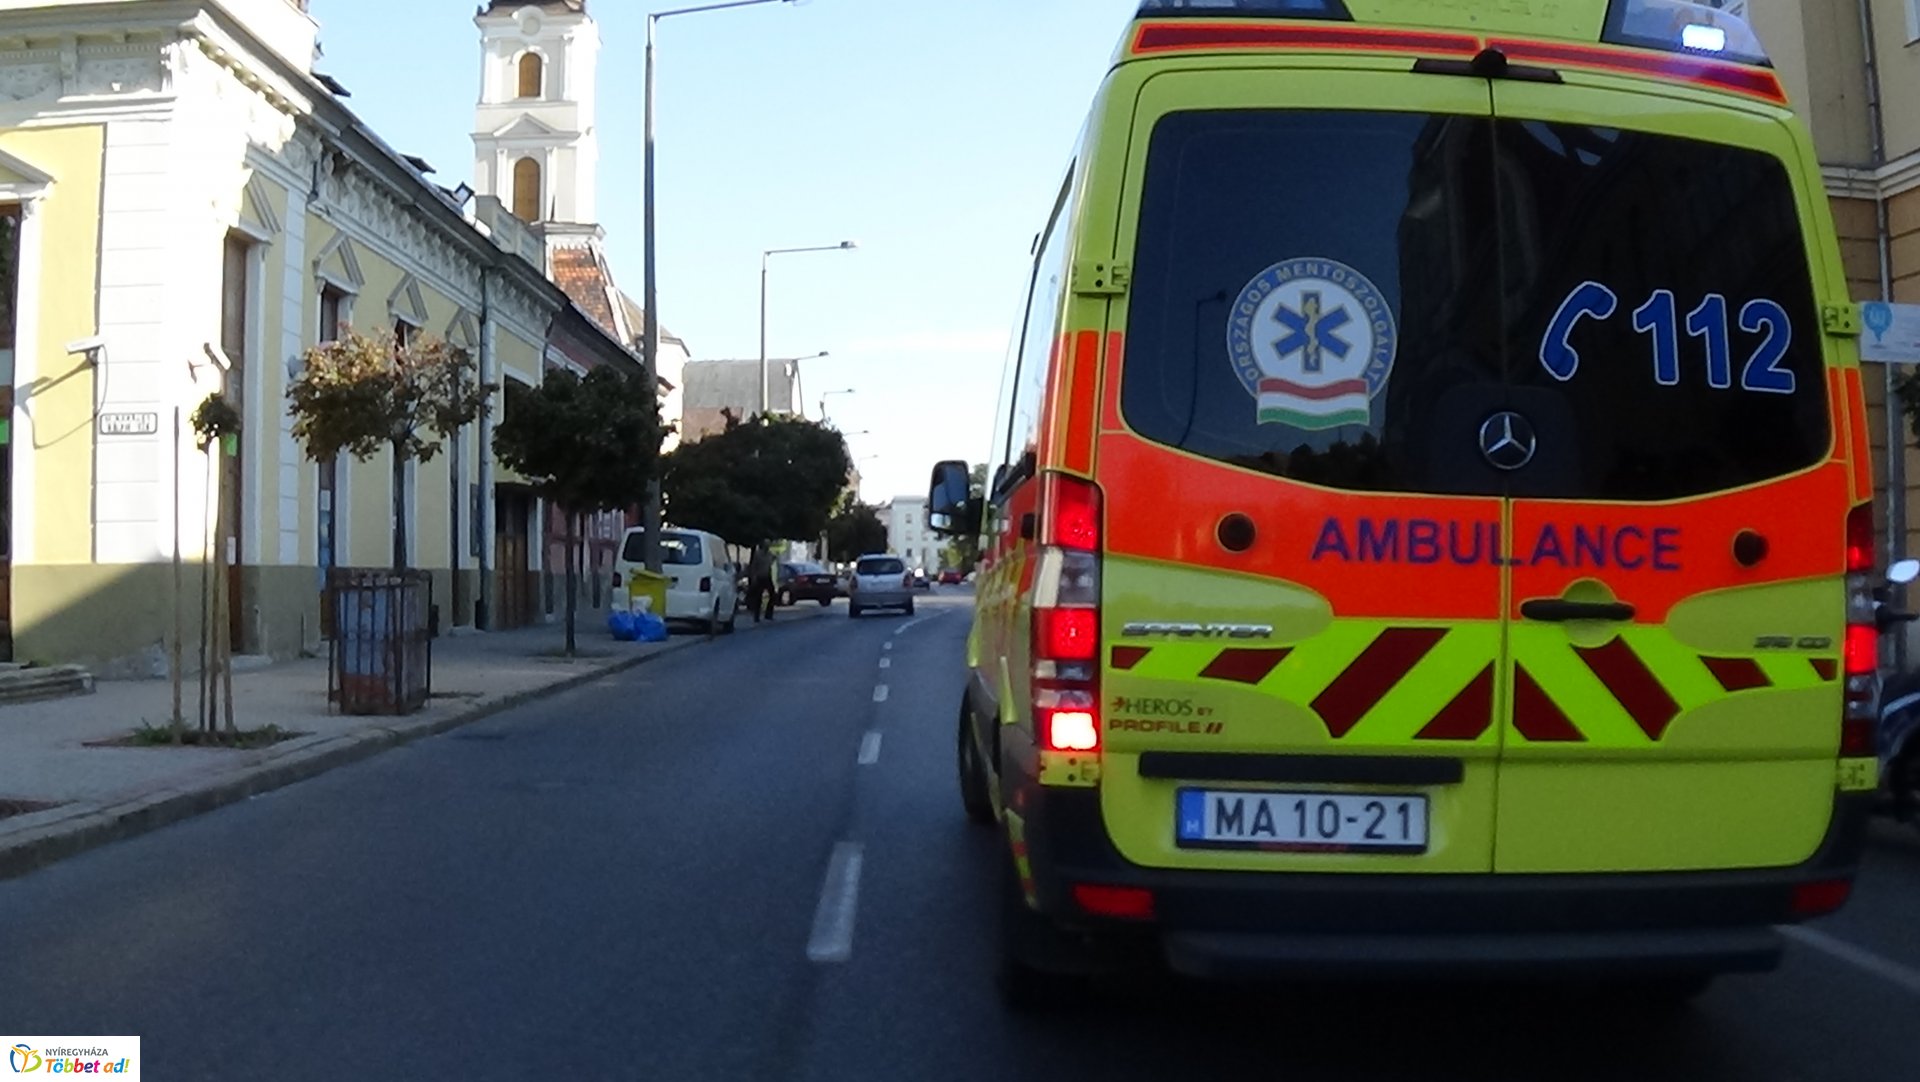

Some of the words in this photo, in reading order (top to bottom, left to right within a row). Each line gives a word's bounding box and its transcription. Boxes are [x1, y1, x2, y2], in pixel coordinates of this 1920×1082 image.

[1633, 289, 1795, 393] 112
[1311, 517, 1682, 571] AMBULANCE
[1109, 719, 1201, 733] PROFILE
[1126, 698, 1193, 716] HEROS
[1216, 798, 1277, 837] MA
[1294, 800, 1410, 840] 10-21
